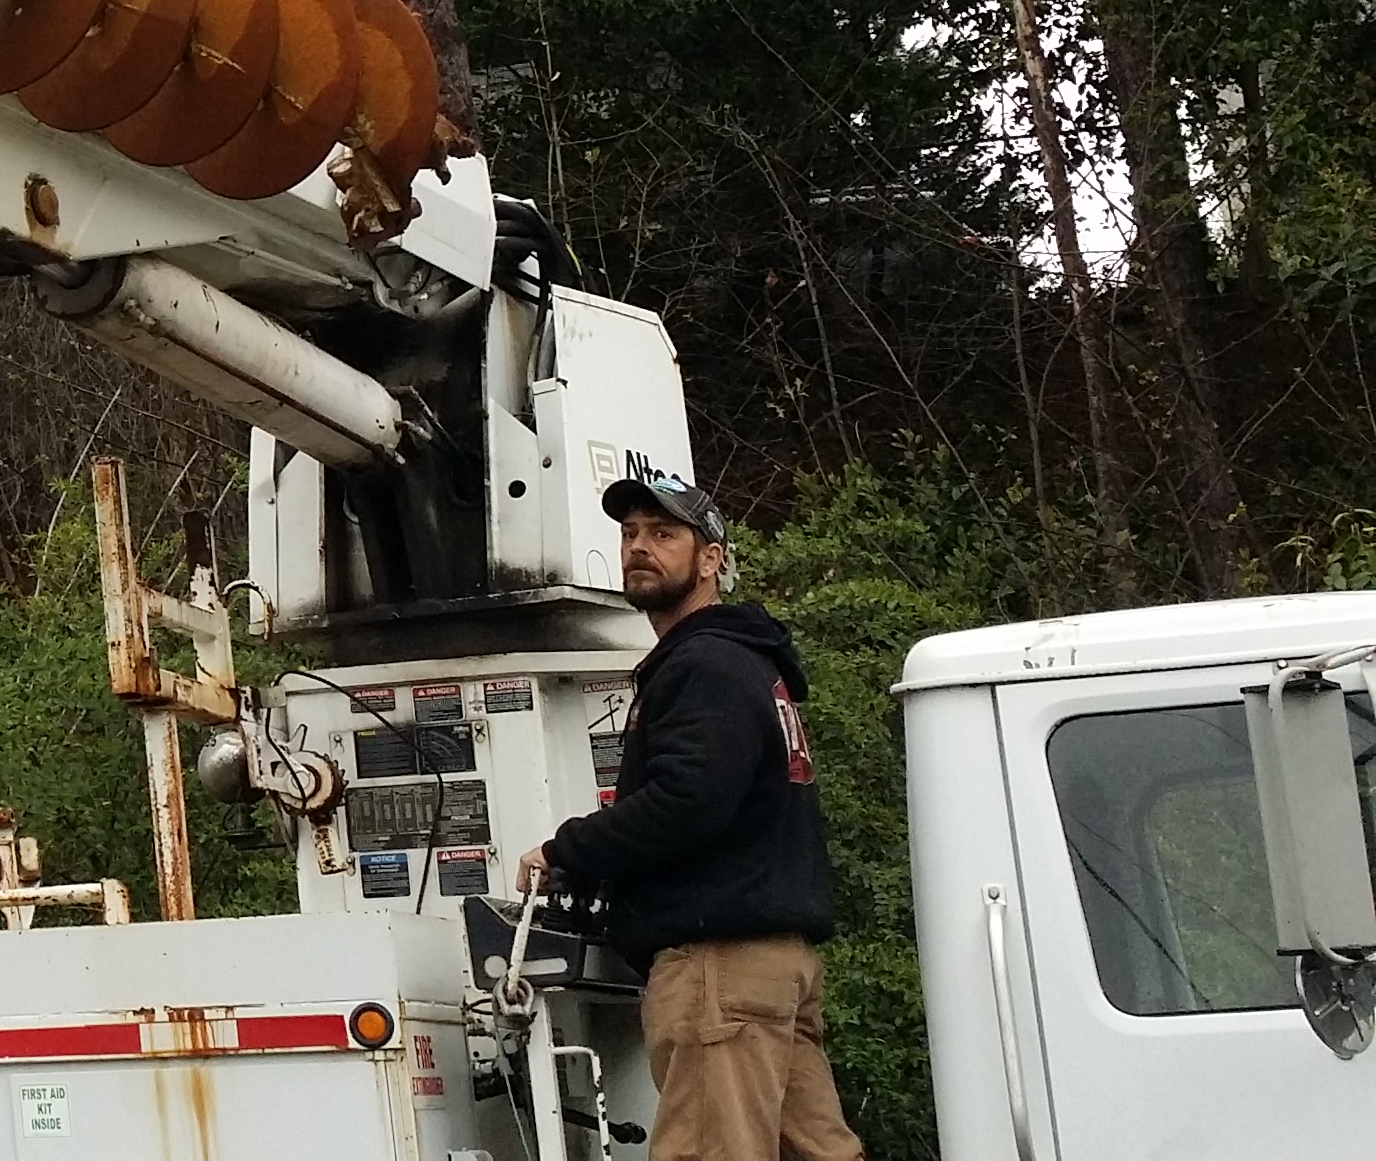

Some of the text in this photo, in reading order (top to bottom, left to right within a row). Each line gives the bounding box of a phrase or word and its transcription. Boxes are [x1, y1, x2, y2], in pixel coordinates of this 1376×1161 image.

[625, 449, 683, 485] Alt
[426, 686, 456, 696] DANGER
[496, 680, 531, 690] DANGER
[591, 680, 631, 691] DANGER
[451, 851, 482, 859] DANGER
[413, 1035, 436, 1069] FIRE
[21, 1087, 66, 1101] FIRST AID
[37, 1103, 53, 1115] KIT
[31, 1118, 62, 1130] INSIDE
